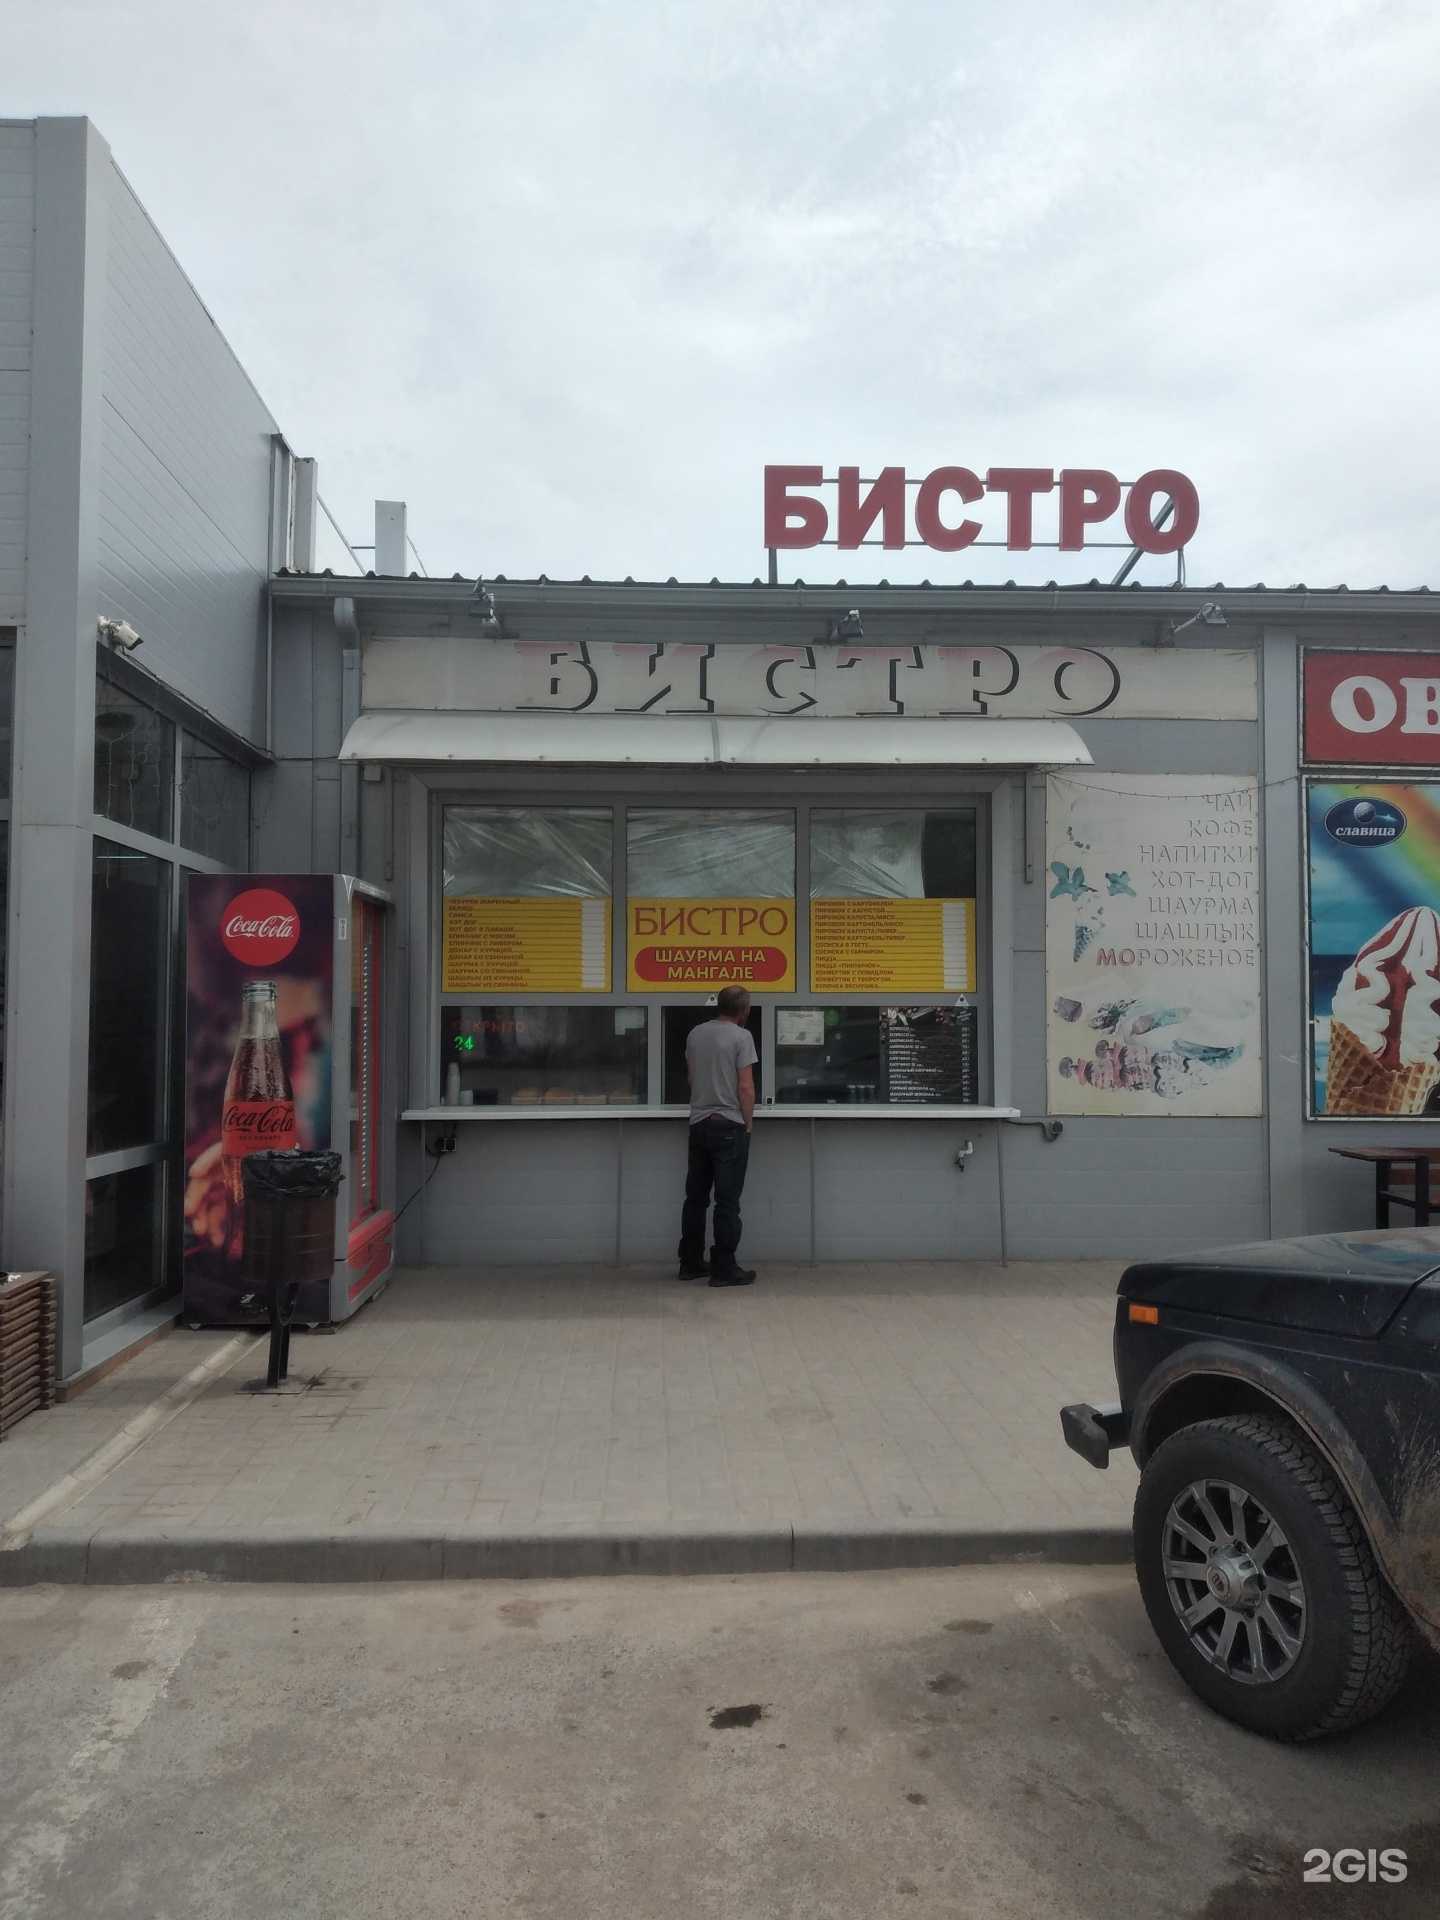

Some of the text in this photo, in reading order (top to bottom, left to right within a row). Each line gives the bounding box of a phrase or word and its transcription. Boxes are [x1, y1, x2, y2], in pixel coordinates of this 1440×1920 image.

[763, 465, 1200, 554] БИСТРО
[515, 641, 1122, 716] БИСТРО
[1189, 819, 1253, 837] КОФЕ
[1335, 826, 1396, 838] славица
[1138, 845, 1253, 864] НАПИТКИ
[1151, 871, 1253, 892] ХОТ-ДОГ
[1149, 896, 1254, 914] ШАУРМА
[225, 914, 297, 938] Coca-Cola
[634, 907, 788, 935] БИСТРО
[1136, 922, 1255, 941] ШАШЛЫК
[655, 950, 766, 963] ШАУРМА НА
[1096, 948, 1255, 966] МОРОЖЕНОЕ
[667, 966, 753, 979] МАНГАЛЕ
[452, 1034, 476, 1052] 24
[223, 1104, 295, 1133] Coca-Cola
